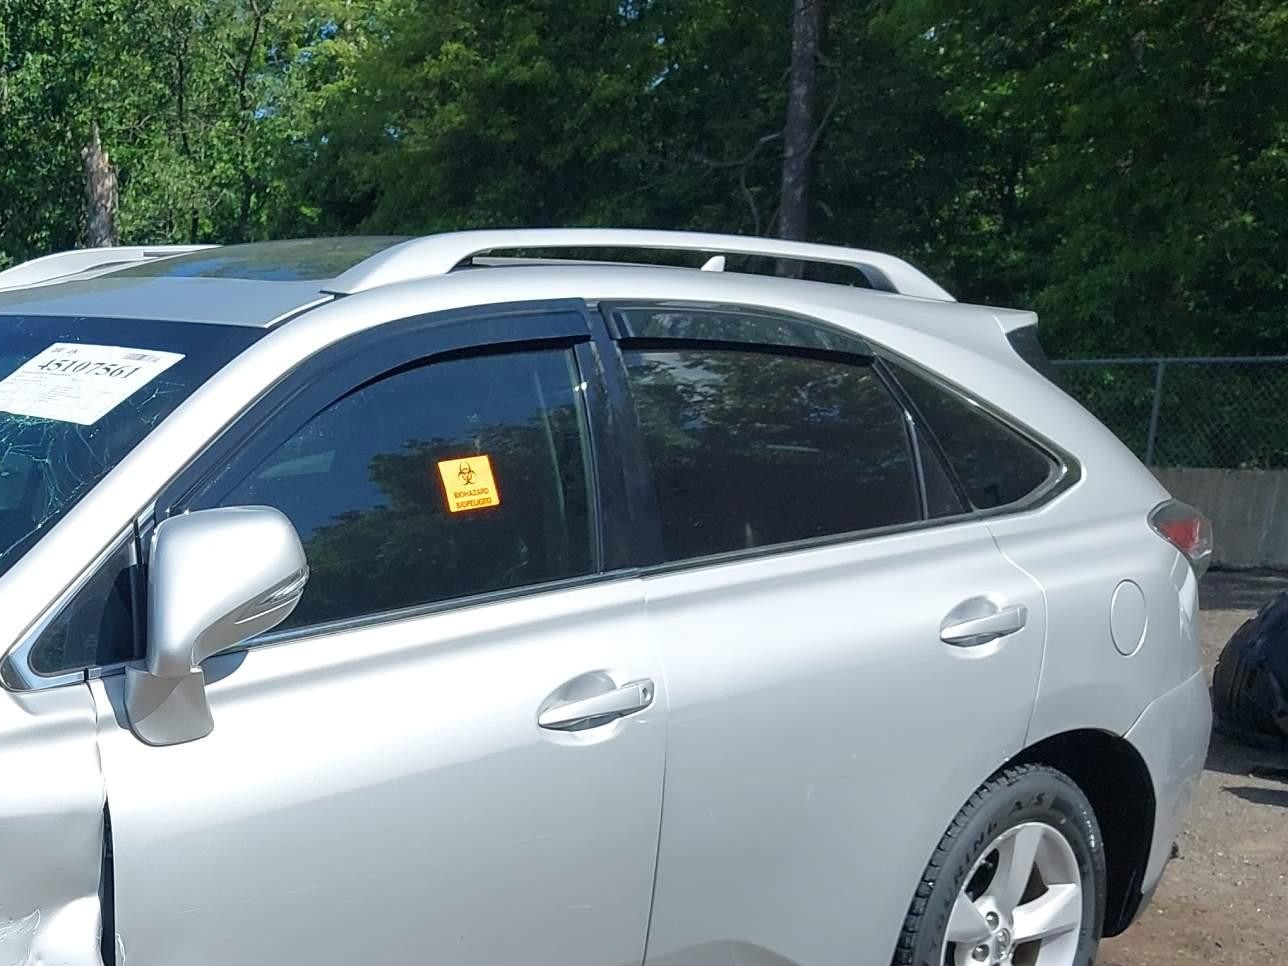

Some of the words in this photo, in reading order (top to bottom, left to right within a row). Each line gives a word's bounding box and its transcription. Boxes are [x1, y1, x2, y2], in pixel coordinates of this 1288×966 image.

[37, 359, 141, 379] 45107561
[454, 488, 489, 499] BIOHAZARD
[456, 497, 492, 509] BIOPELIGRO
